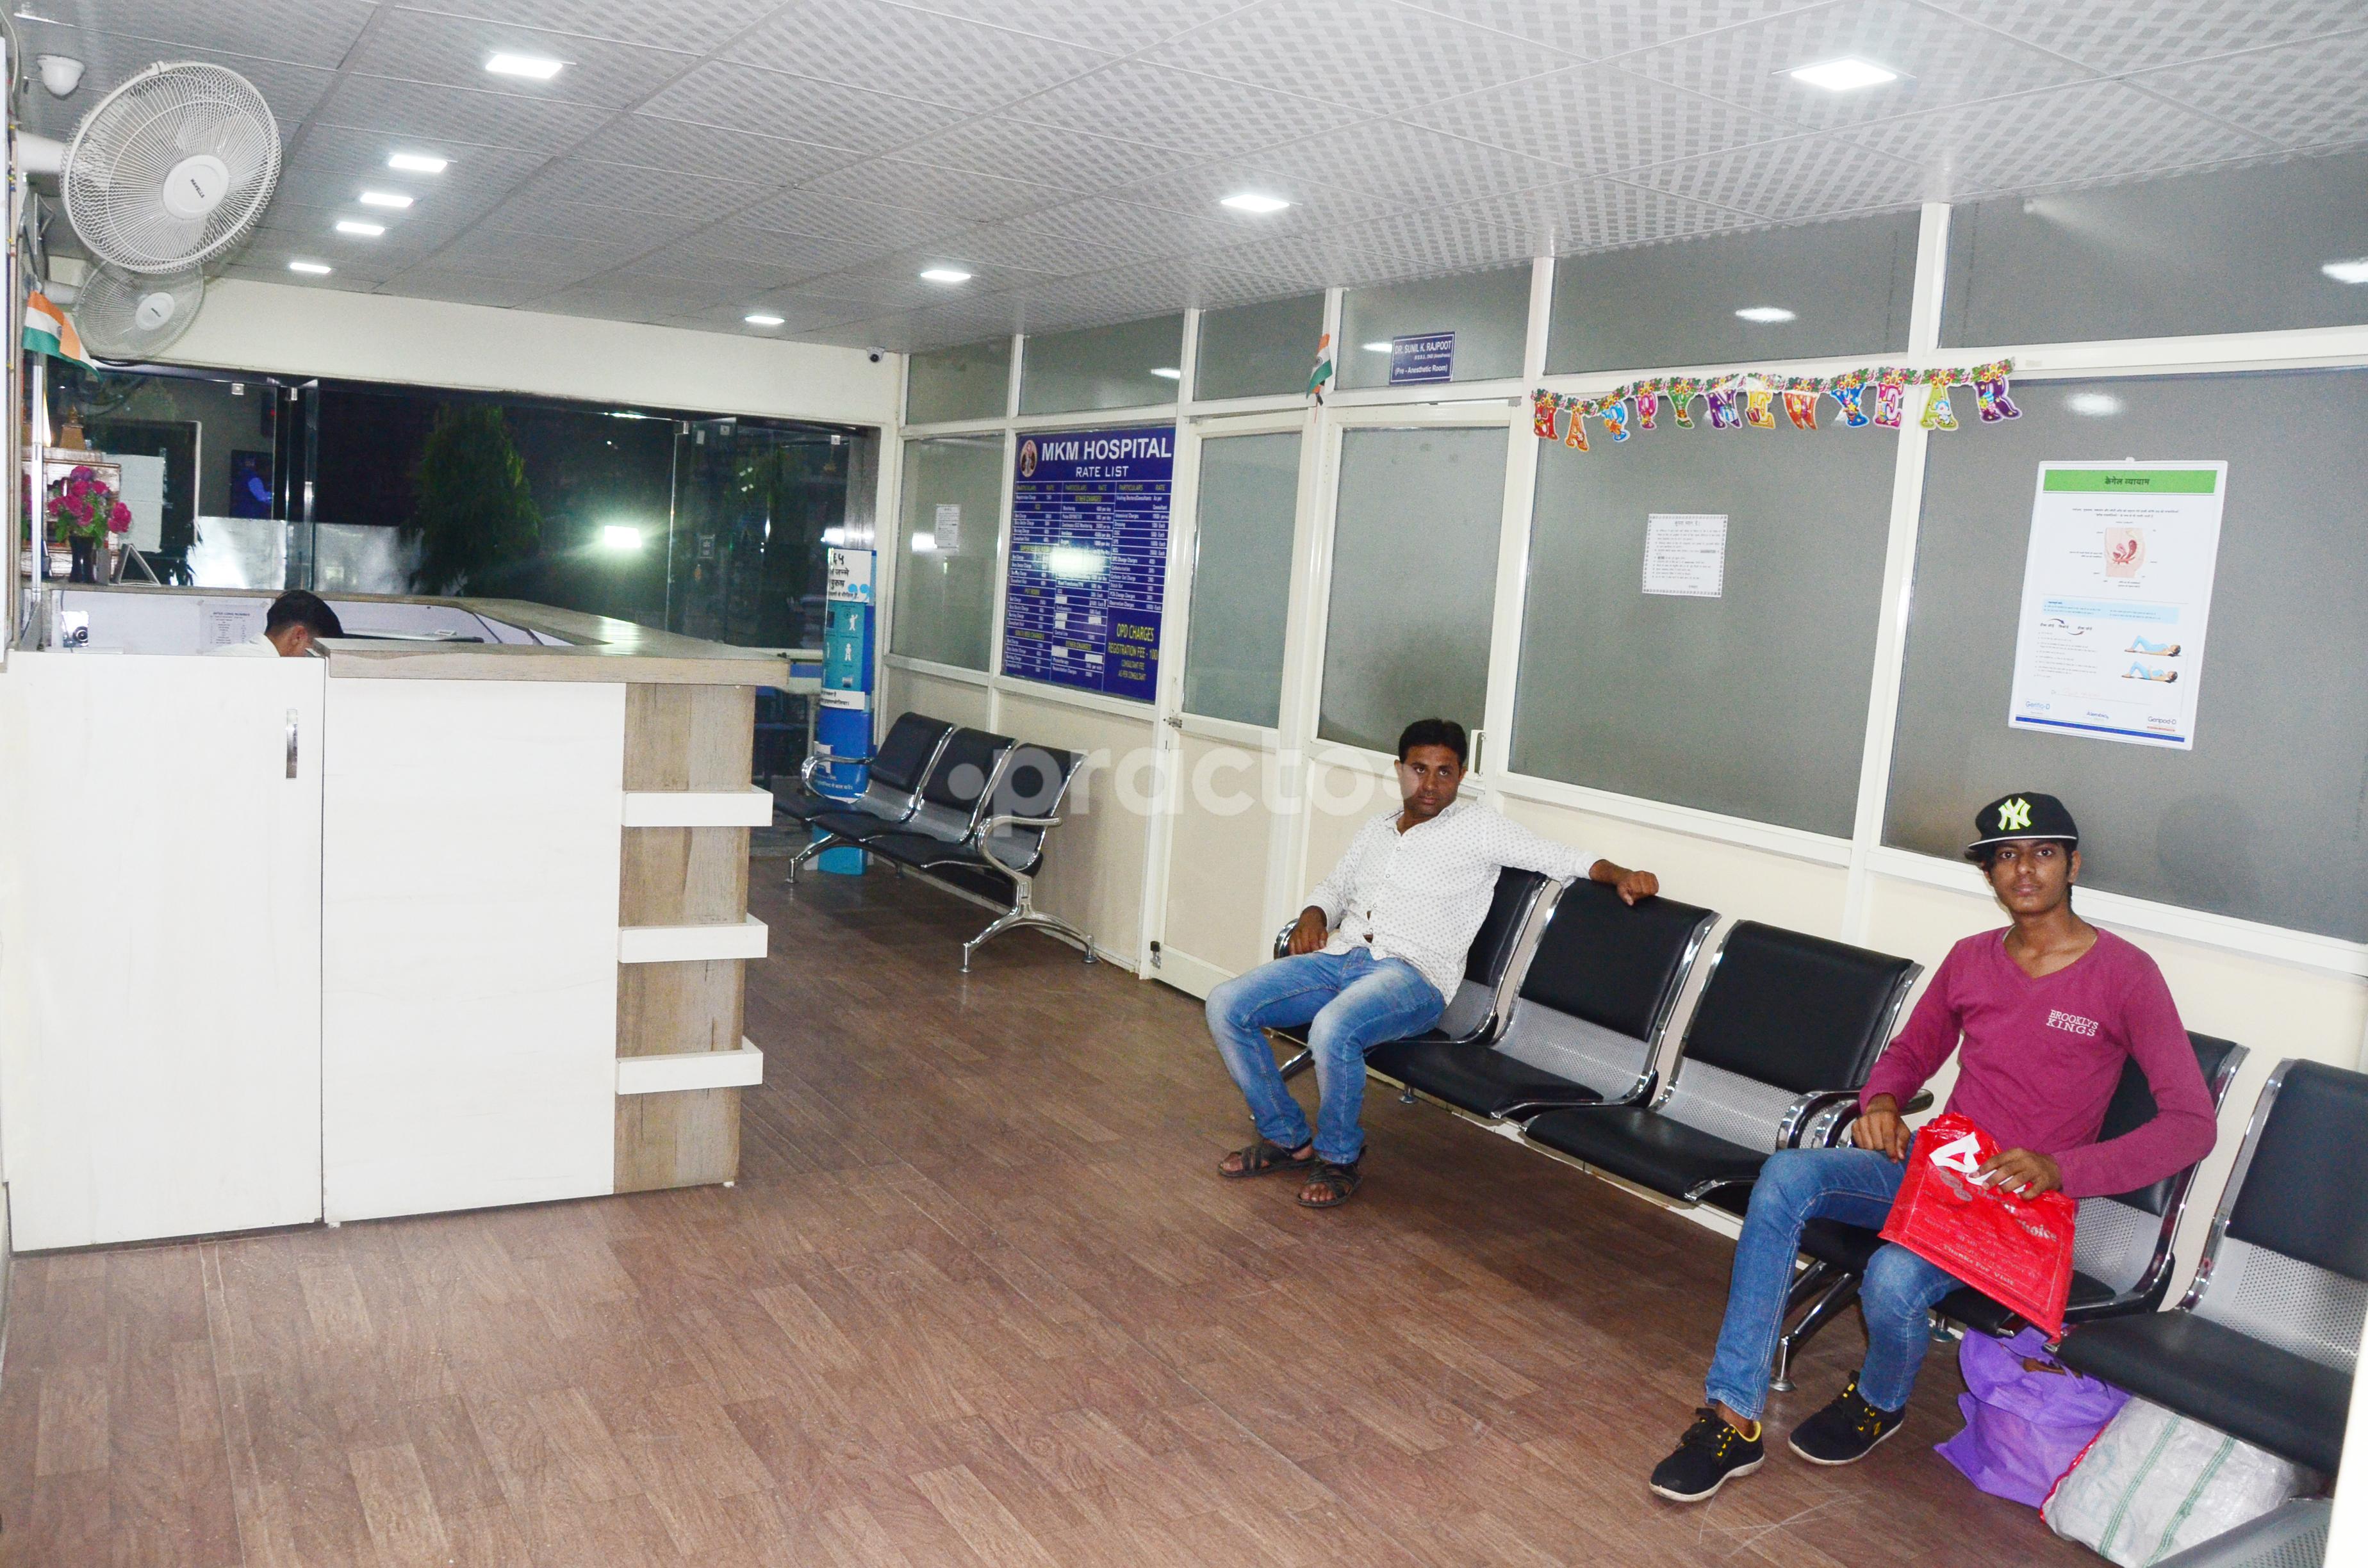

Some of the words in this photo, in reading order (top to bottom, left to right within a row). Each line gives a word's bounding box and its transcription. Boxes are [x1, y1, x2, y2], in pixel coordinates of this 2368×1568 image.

[1395, 345, 1403, 354] DR.
[1404, 343, 1419, 354] SUNIL
[1427, 341, 1452, 351] RAJPOOT
[1534, 388, 1695, 451] HAPPY
[1706, 388, 1818, 430] NEW
[1831, 378, 2023, 431] YEAR
[1042, 441, 1079, 461] MKM
[1084, 437, 1172, 460] HOSPITAL
[1076, 467, 1101, 477] RATE
[1105, 466, 1129, 477] LIST
[2105, 475, 2123, 485] केगेल
[1117, 623, 1128, 638] OPD
[1129, 625, 1155, 642] CHARGES
[1108, 642, 1137, 657] REGISTRATION
[1137, 646, 1146, 658] FEE
[2046, 1017, 2096, 1036] KINGS
[2049, 1009, 2099, 1030] BROOKLYS
